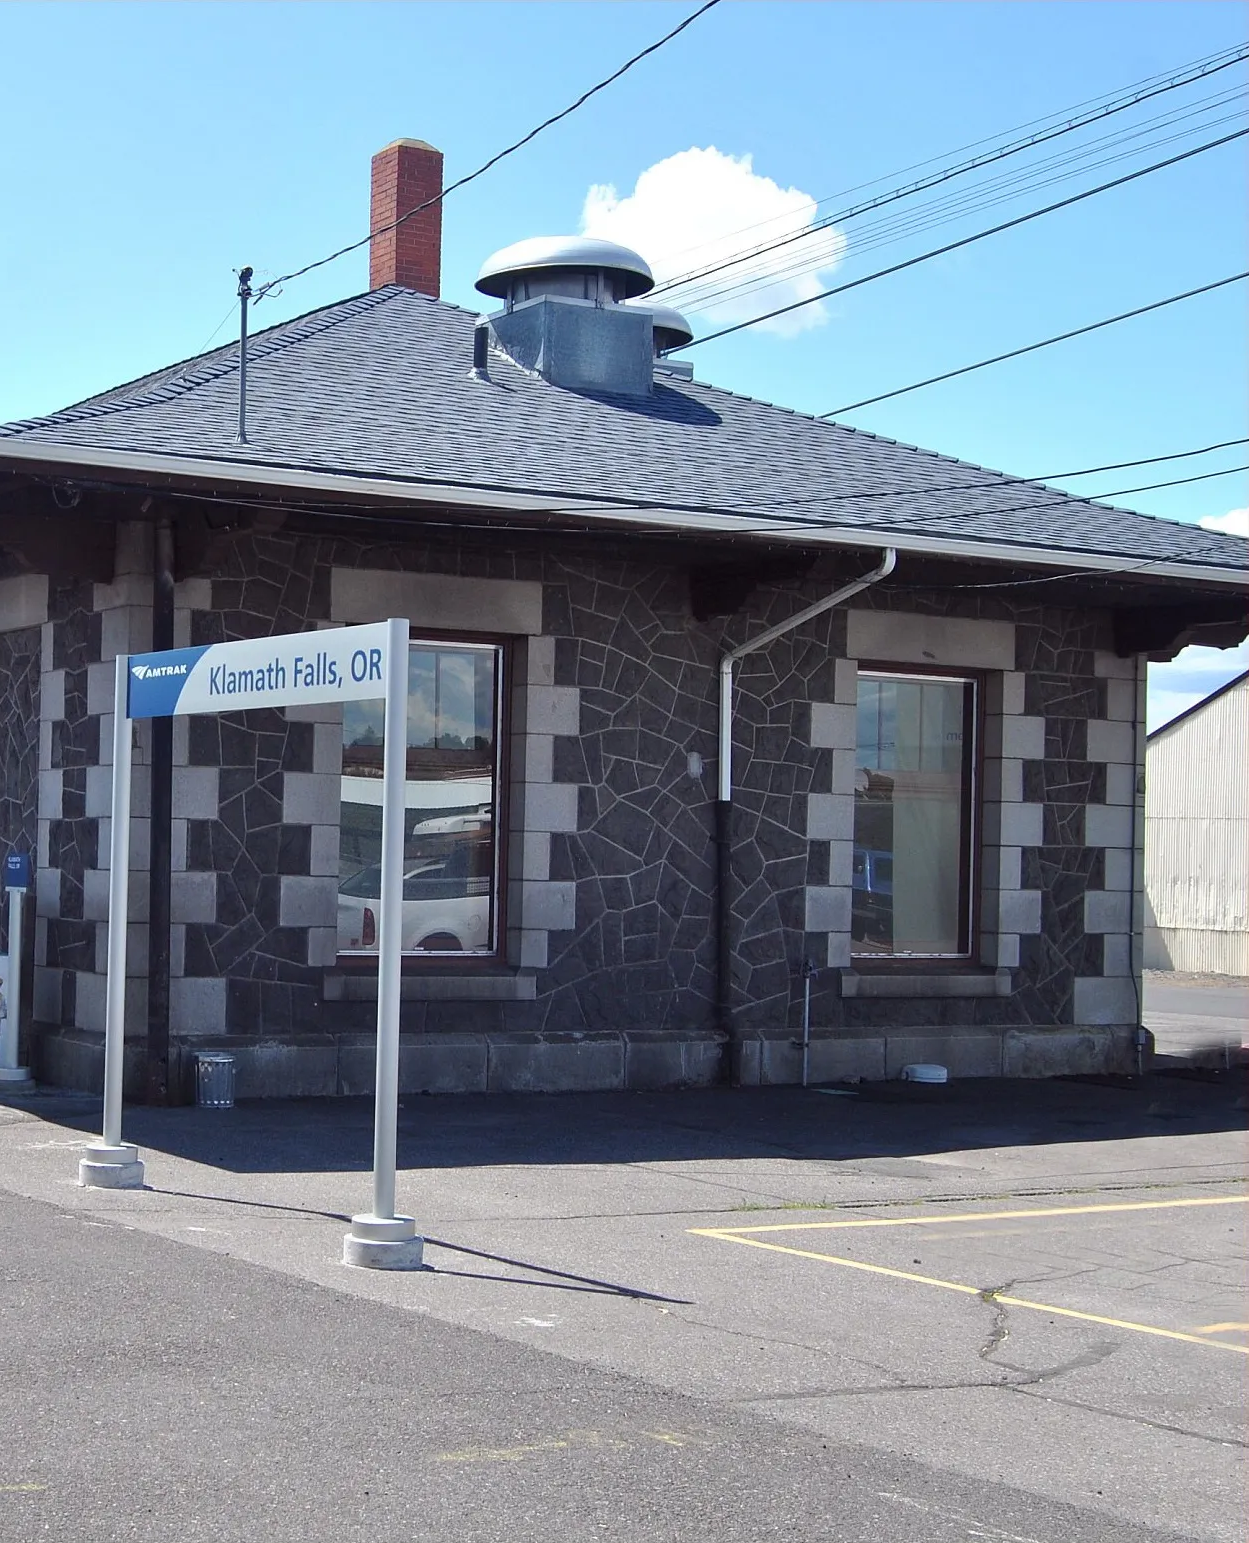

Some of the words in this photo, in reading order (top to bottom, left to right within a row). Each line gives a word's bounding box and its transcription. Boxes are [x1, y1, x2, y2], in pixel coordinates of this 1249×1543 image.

[145, 663, 187, 679] AMTRAK
[208, 658, 286, 696] Klamath
[293, 652, 343, 689] Falls,
[350, 648, 383, 683] OR
